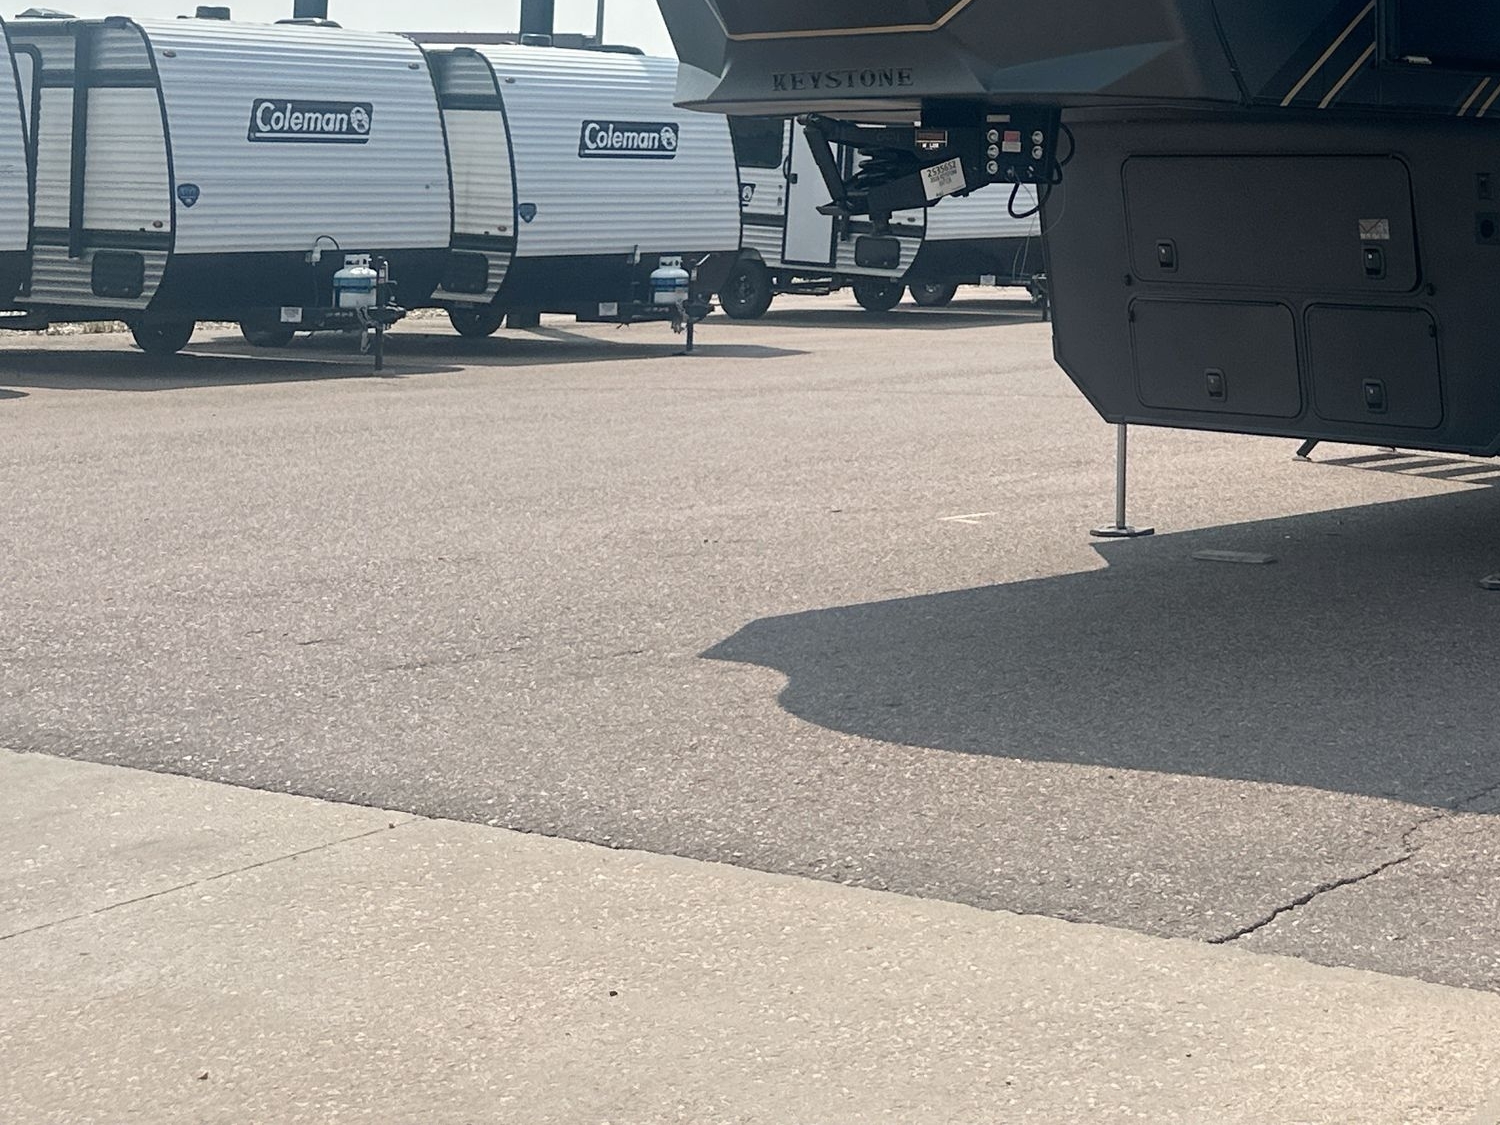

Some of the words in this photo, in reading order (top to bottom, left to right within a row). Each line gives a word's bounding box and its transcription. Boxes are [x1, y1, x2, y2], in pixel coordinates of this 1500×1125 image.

[772, 67, 914, 91] KEYSTONE
[256, 101, 348, 132] Coleman
[584, 122, 659, 149] Coleman
